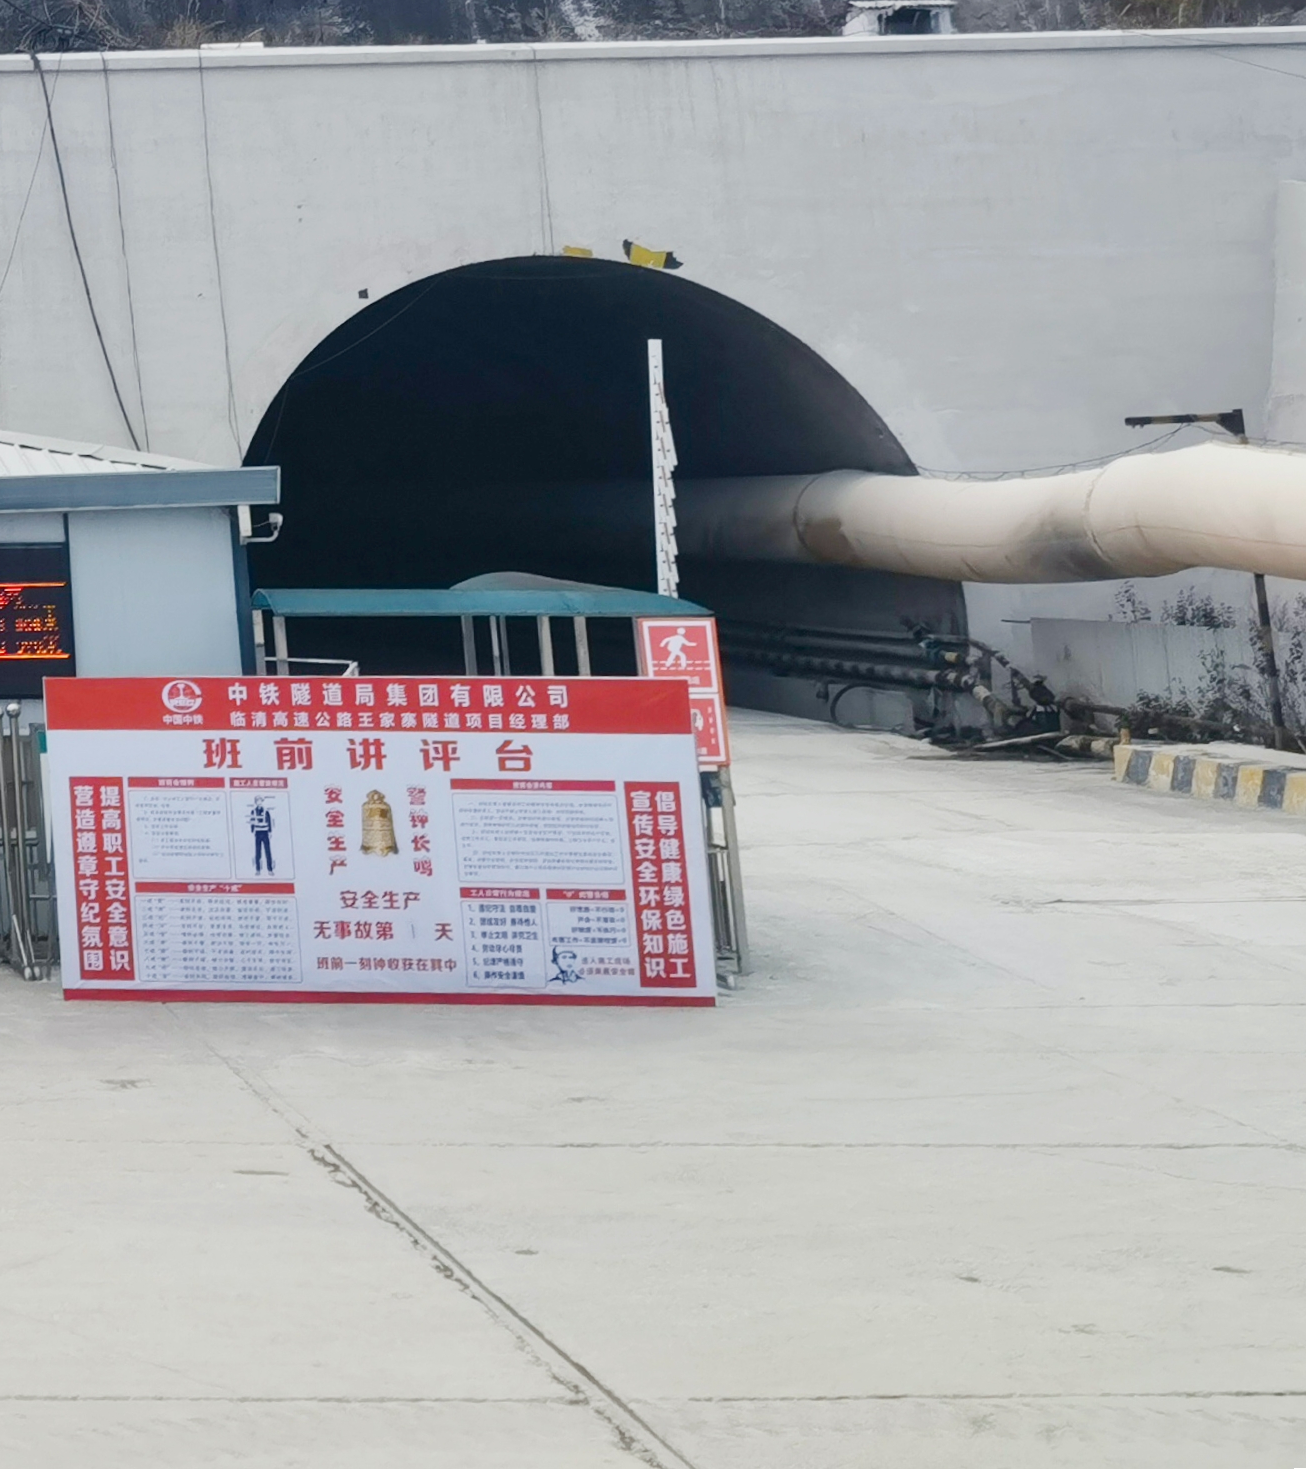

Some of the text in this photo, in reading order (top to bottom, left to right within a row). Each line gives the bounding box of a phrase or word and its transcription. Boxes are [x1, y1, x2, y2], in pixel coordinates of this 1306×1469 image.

[228, 682, 569, 708] 中铁隧道局集团有限公司
[162, 714, 204, 726] 中国中铁
[230, 711, 570, 730] 临清高速公路王家寨隧道项目经理部
[202, 737, 533, 772] 班前讲评台
[324, 784, 347, 875] 安全生产
[407, 784, 433, 876] 警钟长鸣
[74, 786, 104, 971] 营造遵章守纪氛围
[100, 786, 130, 971] 提高职工安全意识
[630, 791, 667, 978] 宣传安全环保知识
[655, 791, 691, 978] 倡导健康绿色施工
[340, 890, 421, 910] 安全生产
[313, 920, 453, 941] 无事故第 天
[316, 956, 457, 972] 班前一刻钟收获在其中
